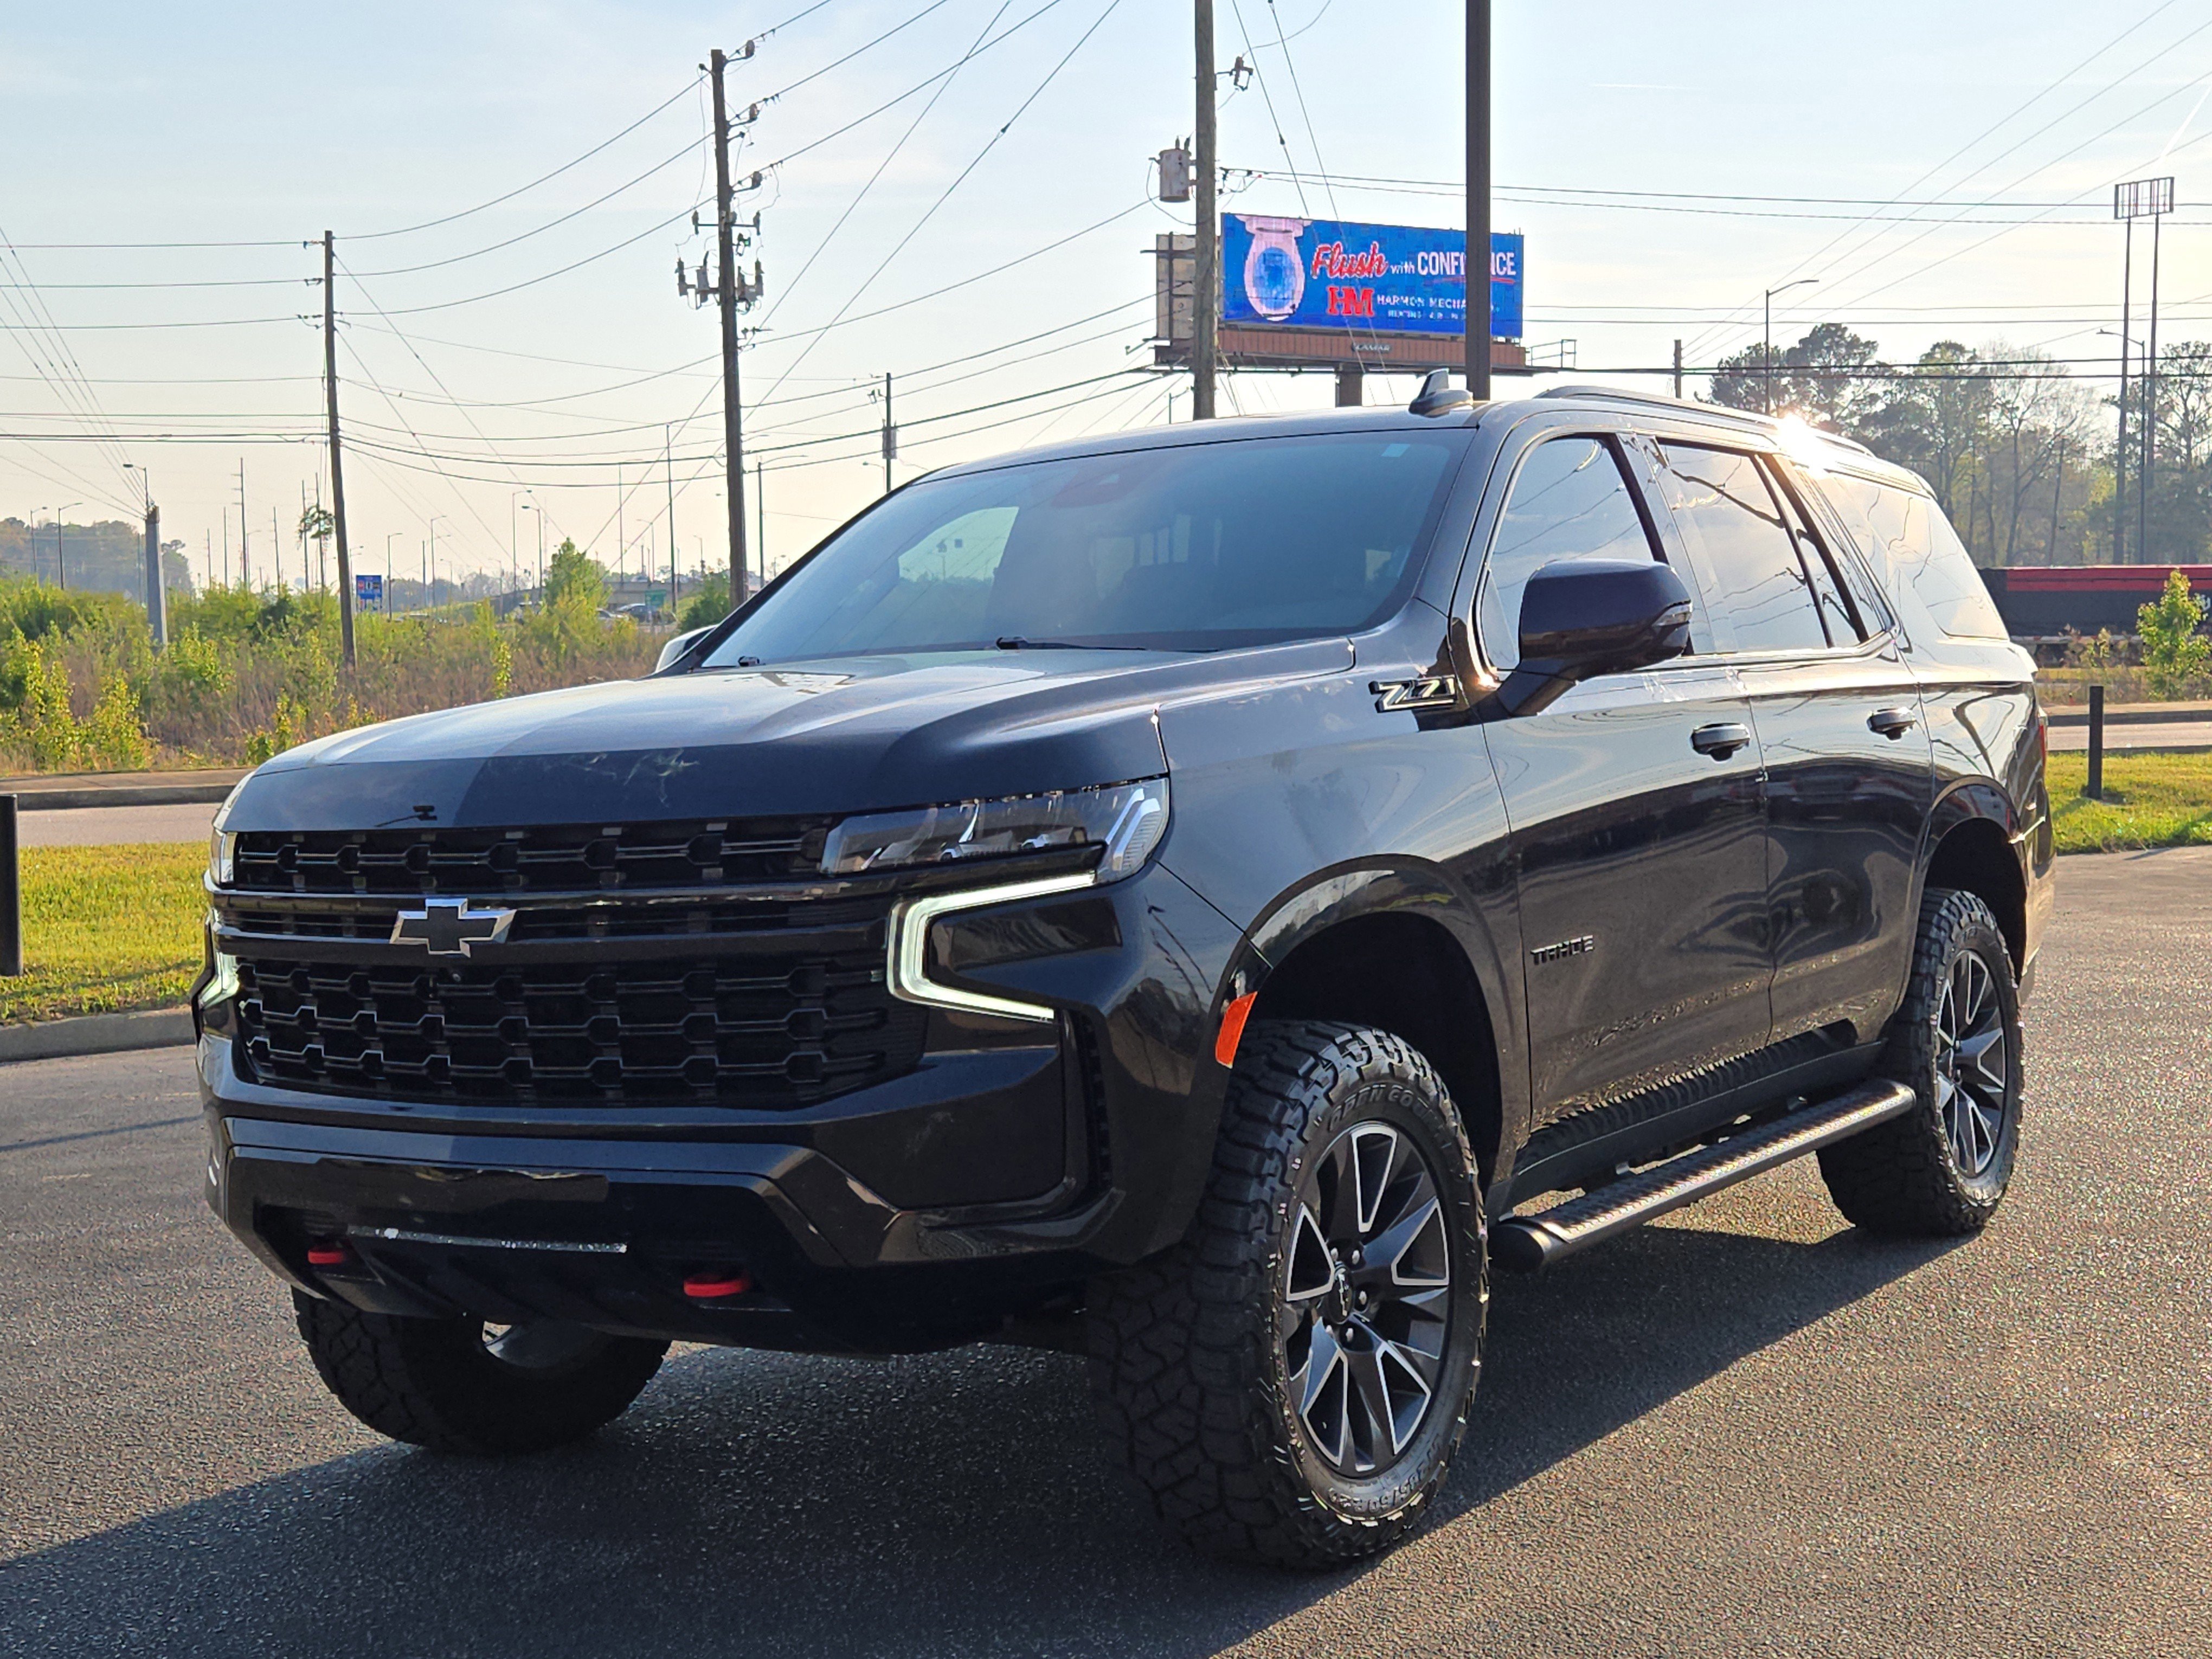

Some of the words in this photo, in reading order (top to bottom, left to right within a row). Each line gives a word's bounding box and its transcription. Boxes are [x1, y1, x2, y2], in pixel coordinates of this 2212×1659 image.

[1310, 241, 1388, 279] Flush
[1390, 261, 1415, 274] with
[1327, 286, 1374, 316] HM
[1368, 674, 1457, 713] Z71
[1531, 935, 1594, 965] TAHOE
